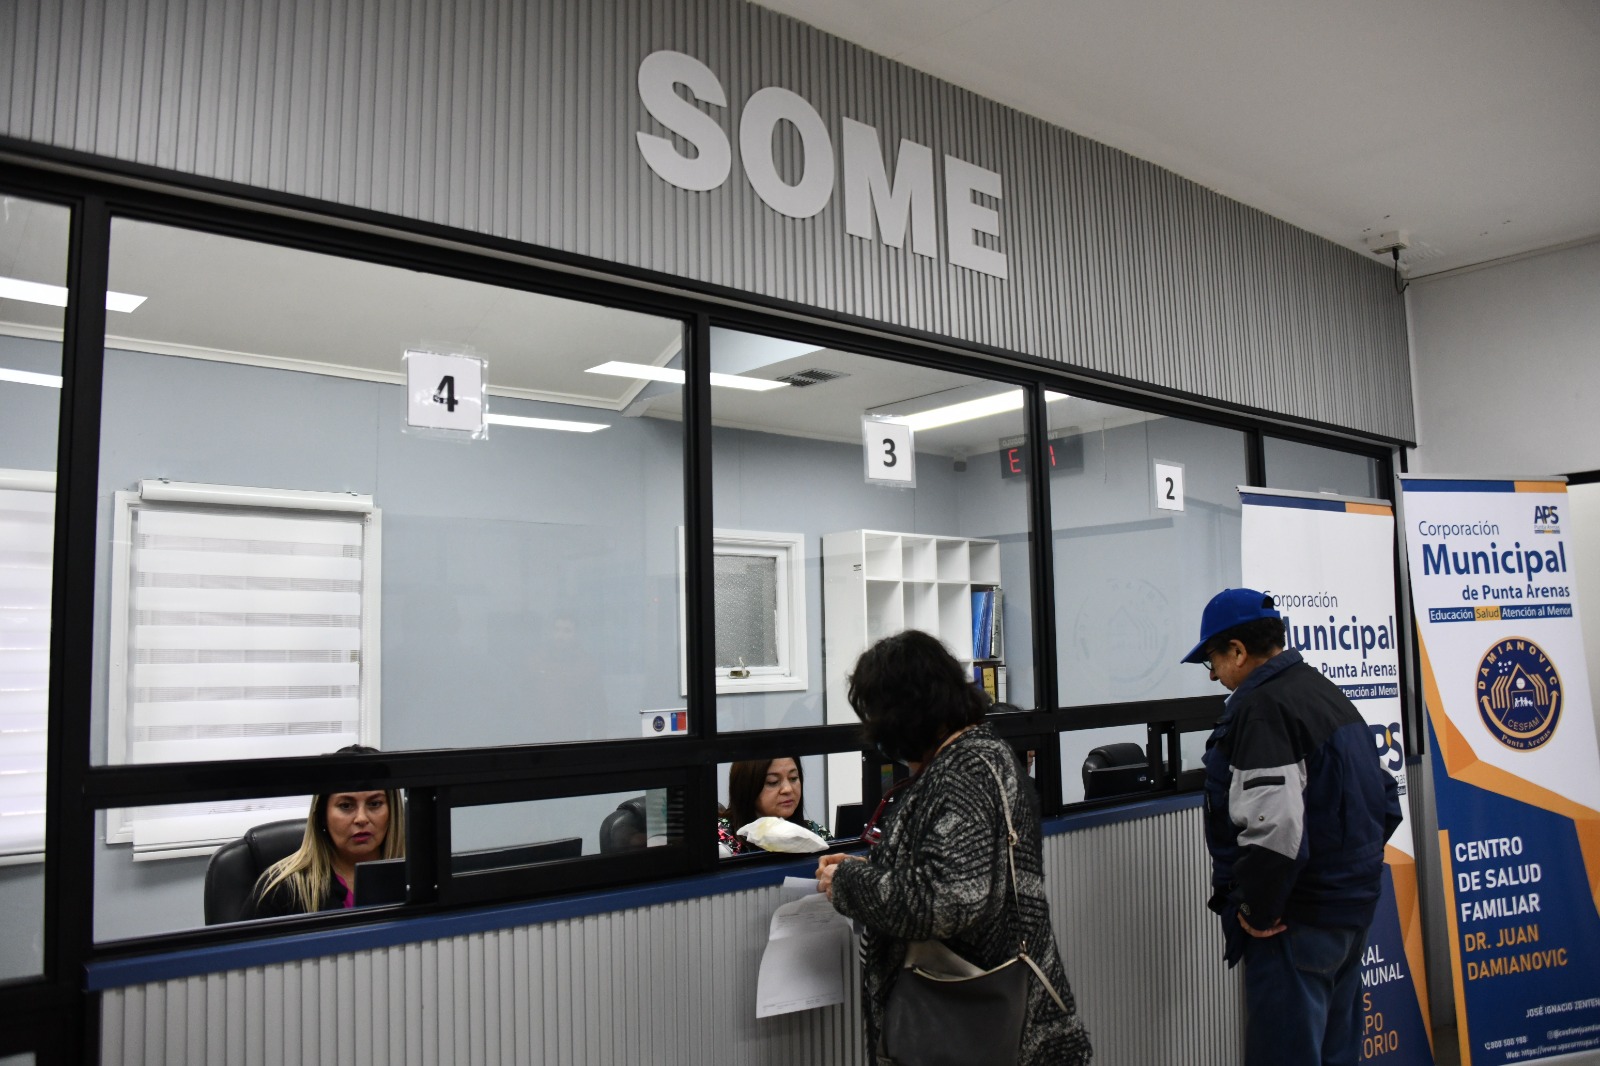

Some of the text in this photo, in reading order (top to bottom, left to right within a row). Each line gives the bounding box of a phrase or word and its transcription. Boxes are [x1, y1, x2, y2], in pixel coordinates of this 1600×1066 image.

[637, 50, 1008, 280] SOME
[433, 375, 459, 412] 4
[882, 438, 897, 468] 3
[1165, 476, 1175, 500] 2
[1534, 505, 1559, 524] APS
[1418, 520, 1500, 540] Corporación
[1422, 541, 1567, 582] Municipal
[1262, 590, 1338, 611] orporación
[1462, 584, 1570, 600] de Punta Arenas
[1430, 605, 1571, 620] Educación Salud Atención al Menor
[1321, 662, 1397, 678] Punta Arenas
[1478, 641, 1558, 690] DAMIANOVIC
[1342, 688, 1370, 698] tención
[1370, 687, 1376, 696] al
[1508, 716, 1540, 731] CESFAM
[1368, 722, 1403, 771] PS
[1501, 730, 1551, 748] Punta Arenas
[1455, 836, 1523, 862] CENTRO
[1458, 863, 1542, 892] DE SALUD
[1461, 893, 1541, 922] FAMILIAR
[1464, 924, 1540, 952] DR. JUAN
[1361, 962, 1404, 988] MUNAL
[1467, 948, 1568, 981] DAMIANOVIC
[1526, 997, 1600, 1018] JOSÉ IGNACIO ZENTEN
